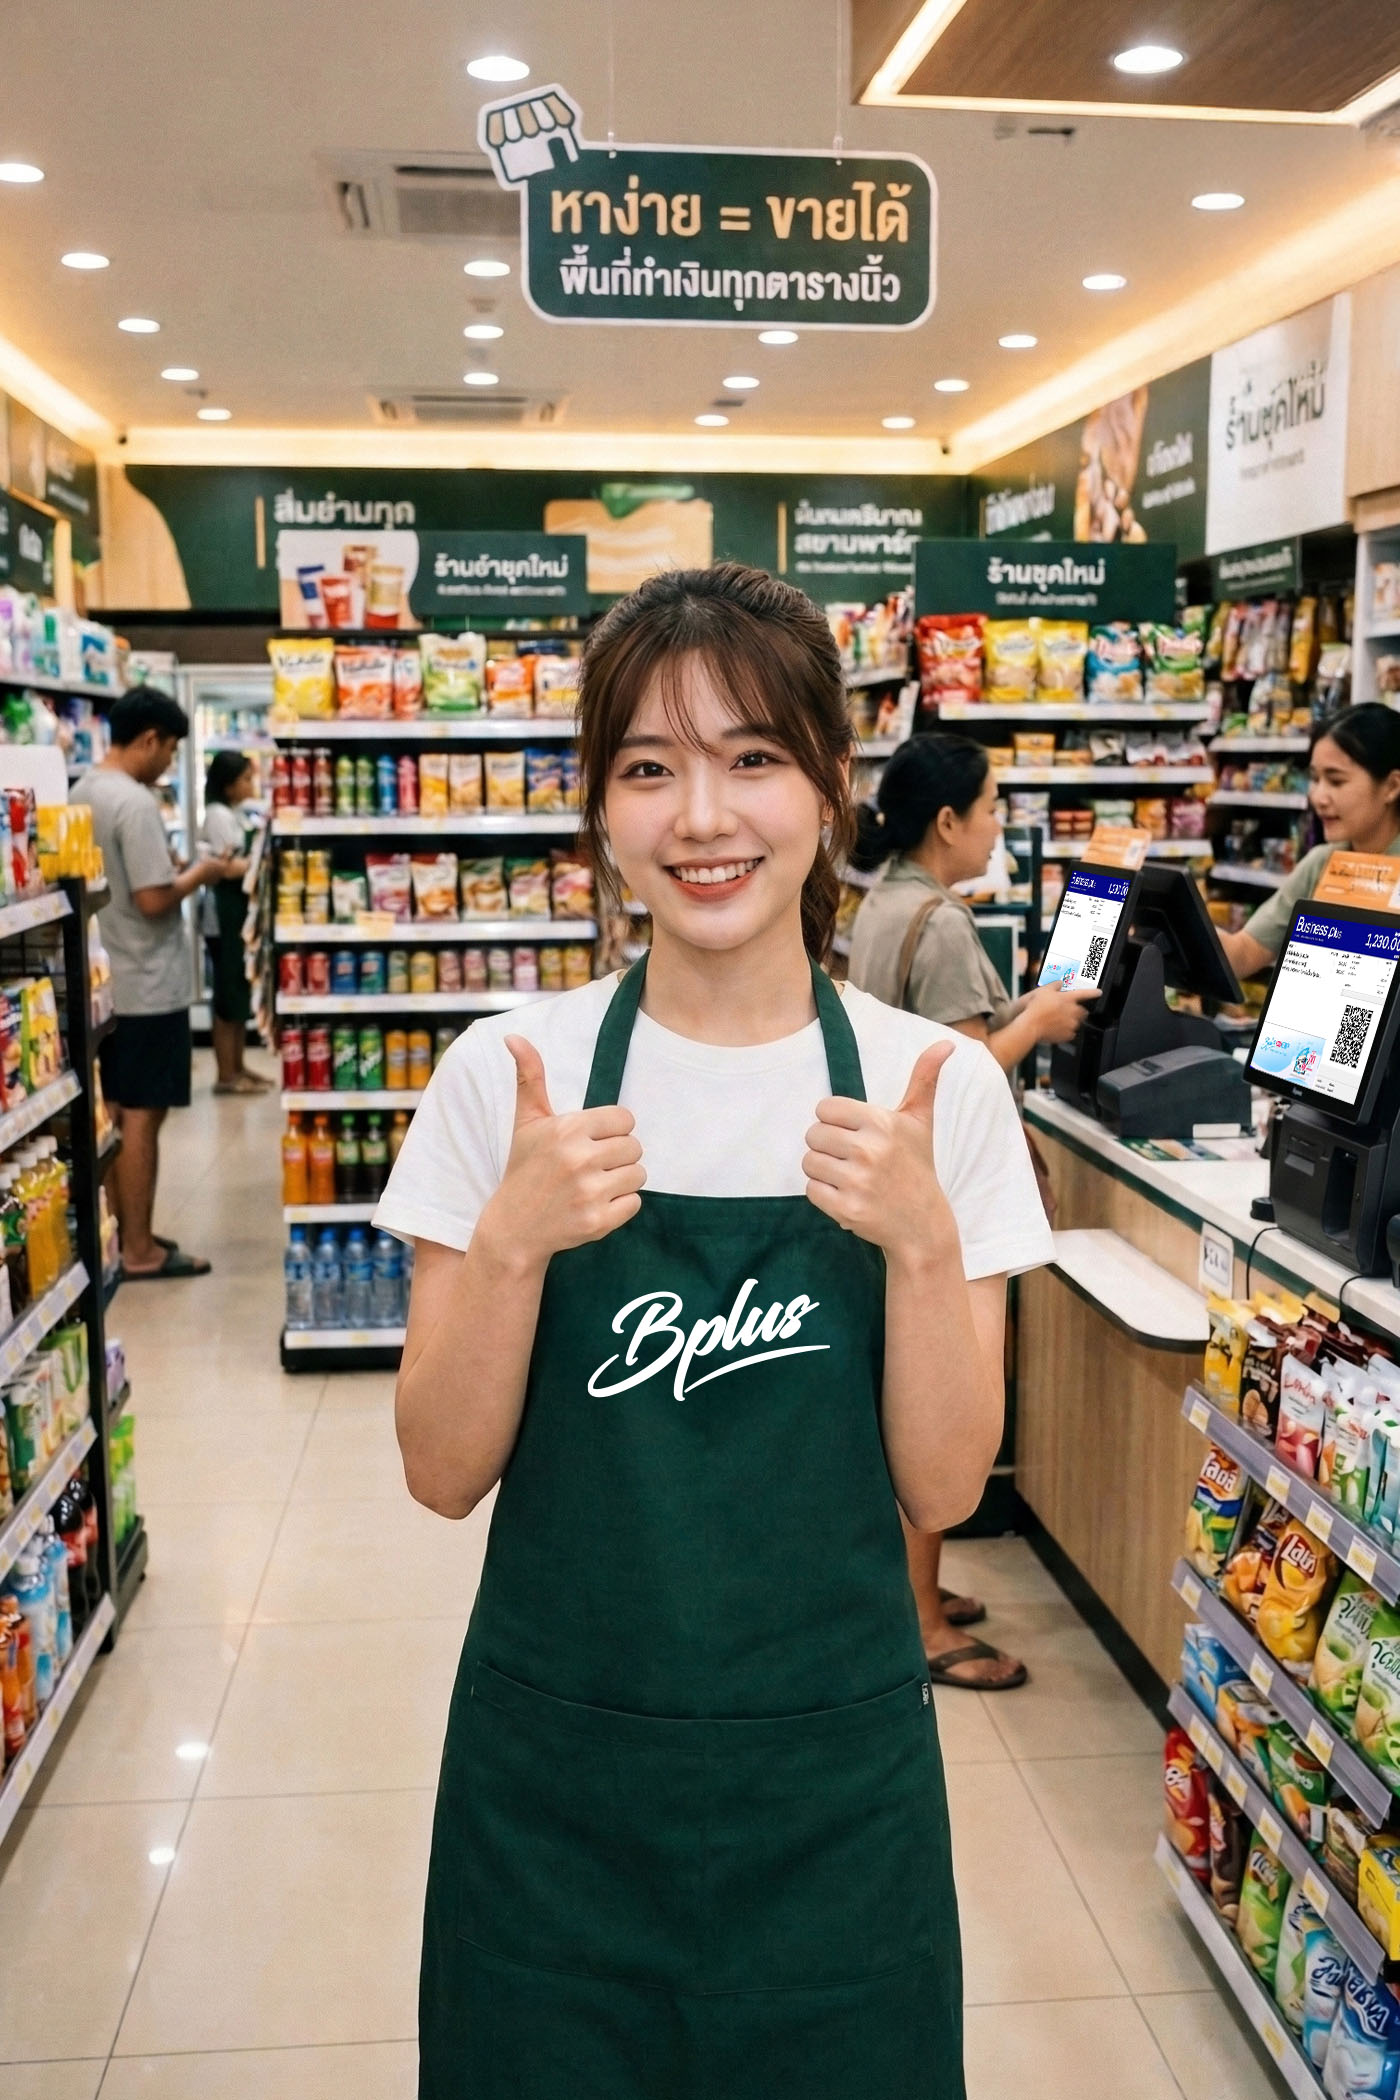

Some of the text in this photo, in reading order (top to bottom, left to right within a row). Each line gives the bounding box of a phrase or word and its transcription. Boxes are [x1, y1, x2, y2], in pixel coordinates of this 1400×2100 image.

[551, 175, 702, 237] หาง่าย
[765, 181, 912, 243] ขายได้
[559, 244, 901, 312] พื้นที่ทำเงินทุกตารางนิ้ว
[1295, 915, 1330, 938] Business
[587, 1278, 821, 1402] Bplus
